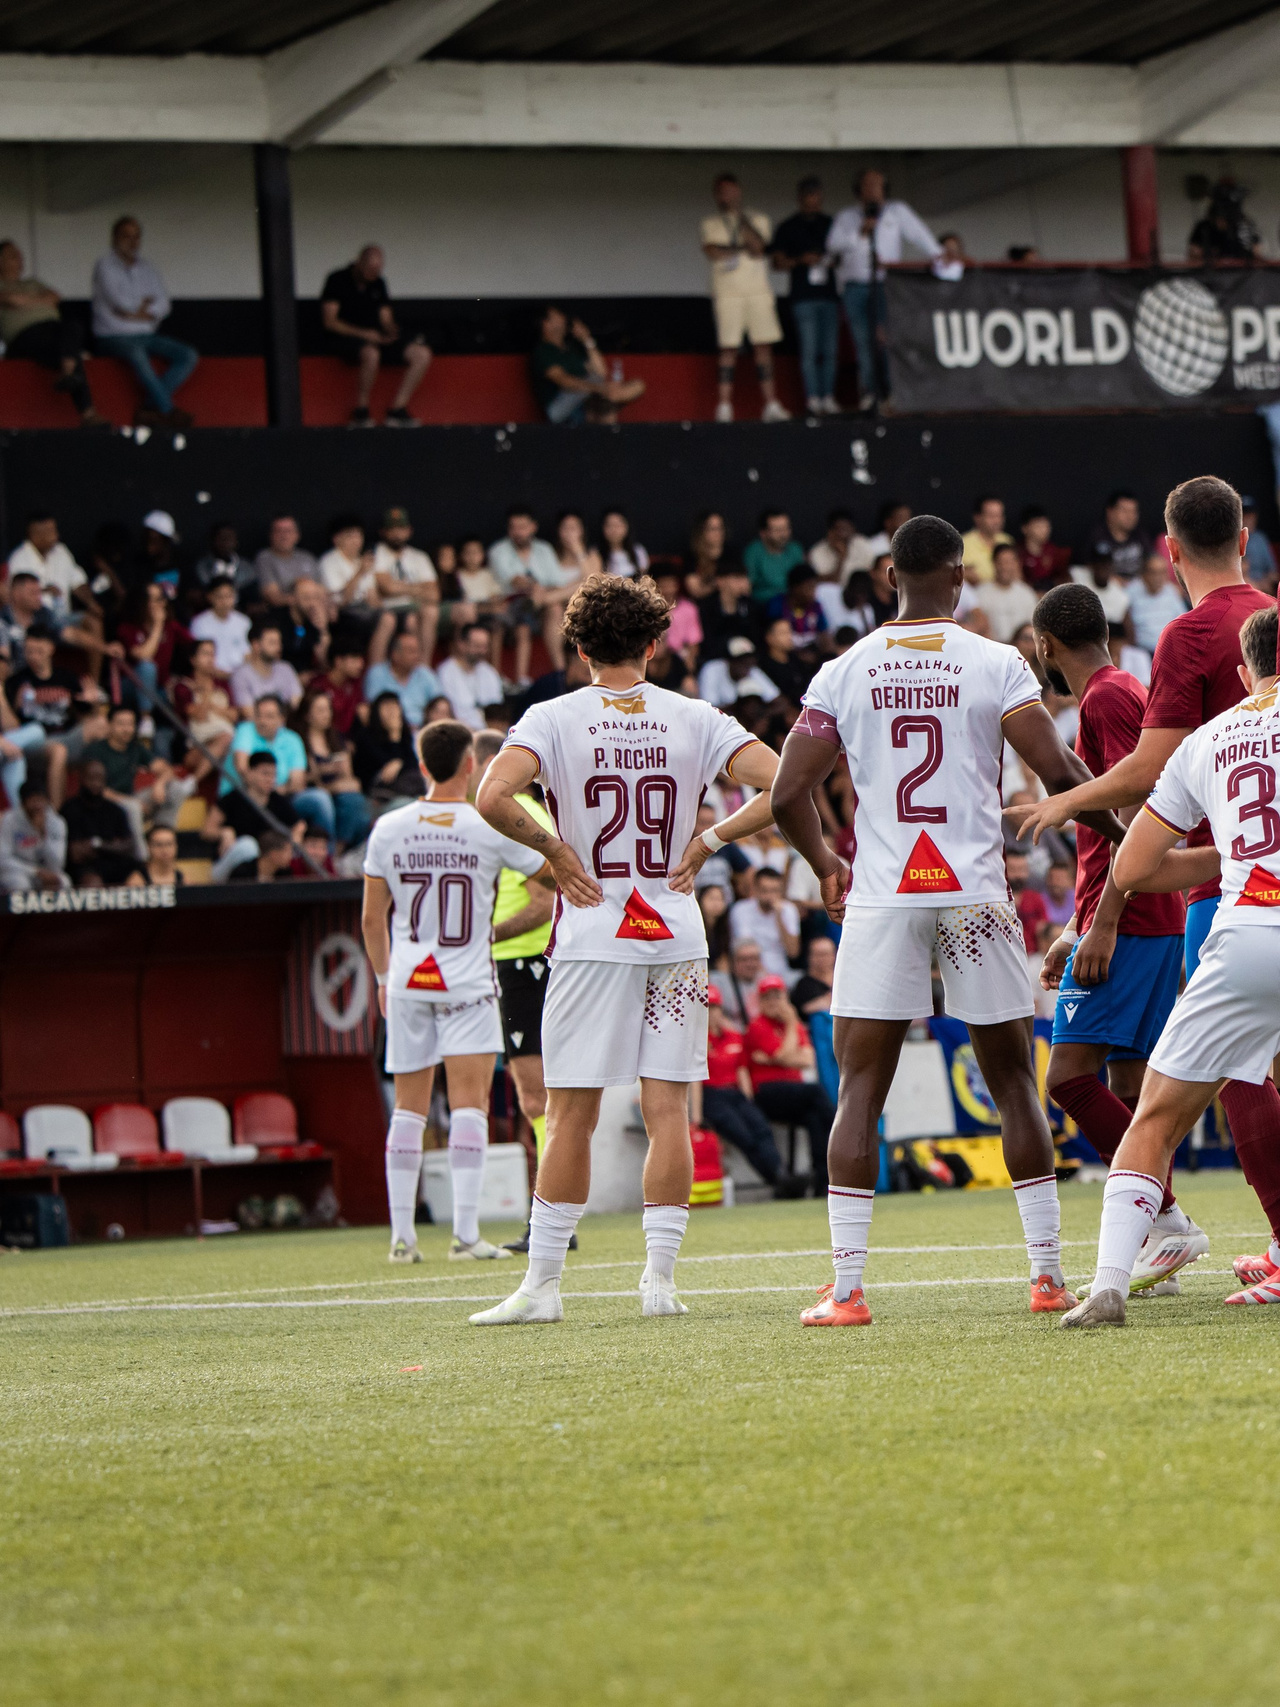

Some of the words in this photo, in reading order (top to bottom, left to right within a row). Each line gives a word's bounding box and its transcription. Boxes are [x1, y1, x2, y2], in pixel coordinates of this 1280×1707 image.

[934, 308, 1130, 368] WORLD
[867, 659, 963, 678] D'BACALHAU
[890, 676, 941, 685] RESTAURANTE
[870, 684, 960, 711] DERITSON
[593, 747, 609, 769] P.
[614, 746, 667, 770] ROCHA
[891, 714, 948, 824] 2
[584, 774, 678, 879] 29
[408, 852, 479, 871] QUARESMA
[909, 867, 950, 880] DELTA
[9, 885, 177, 914] SACAVENENSE
[400, 873, 473, 947] 70
